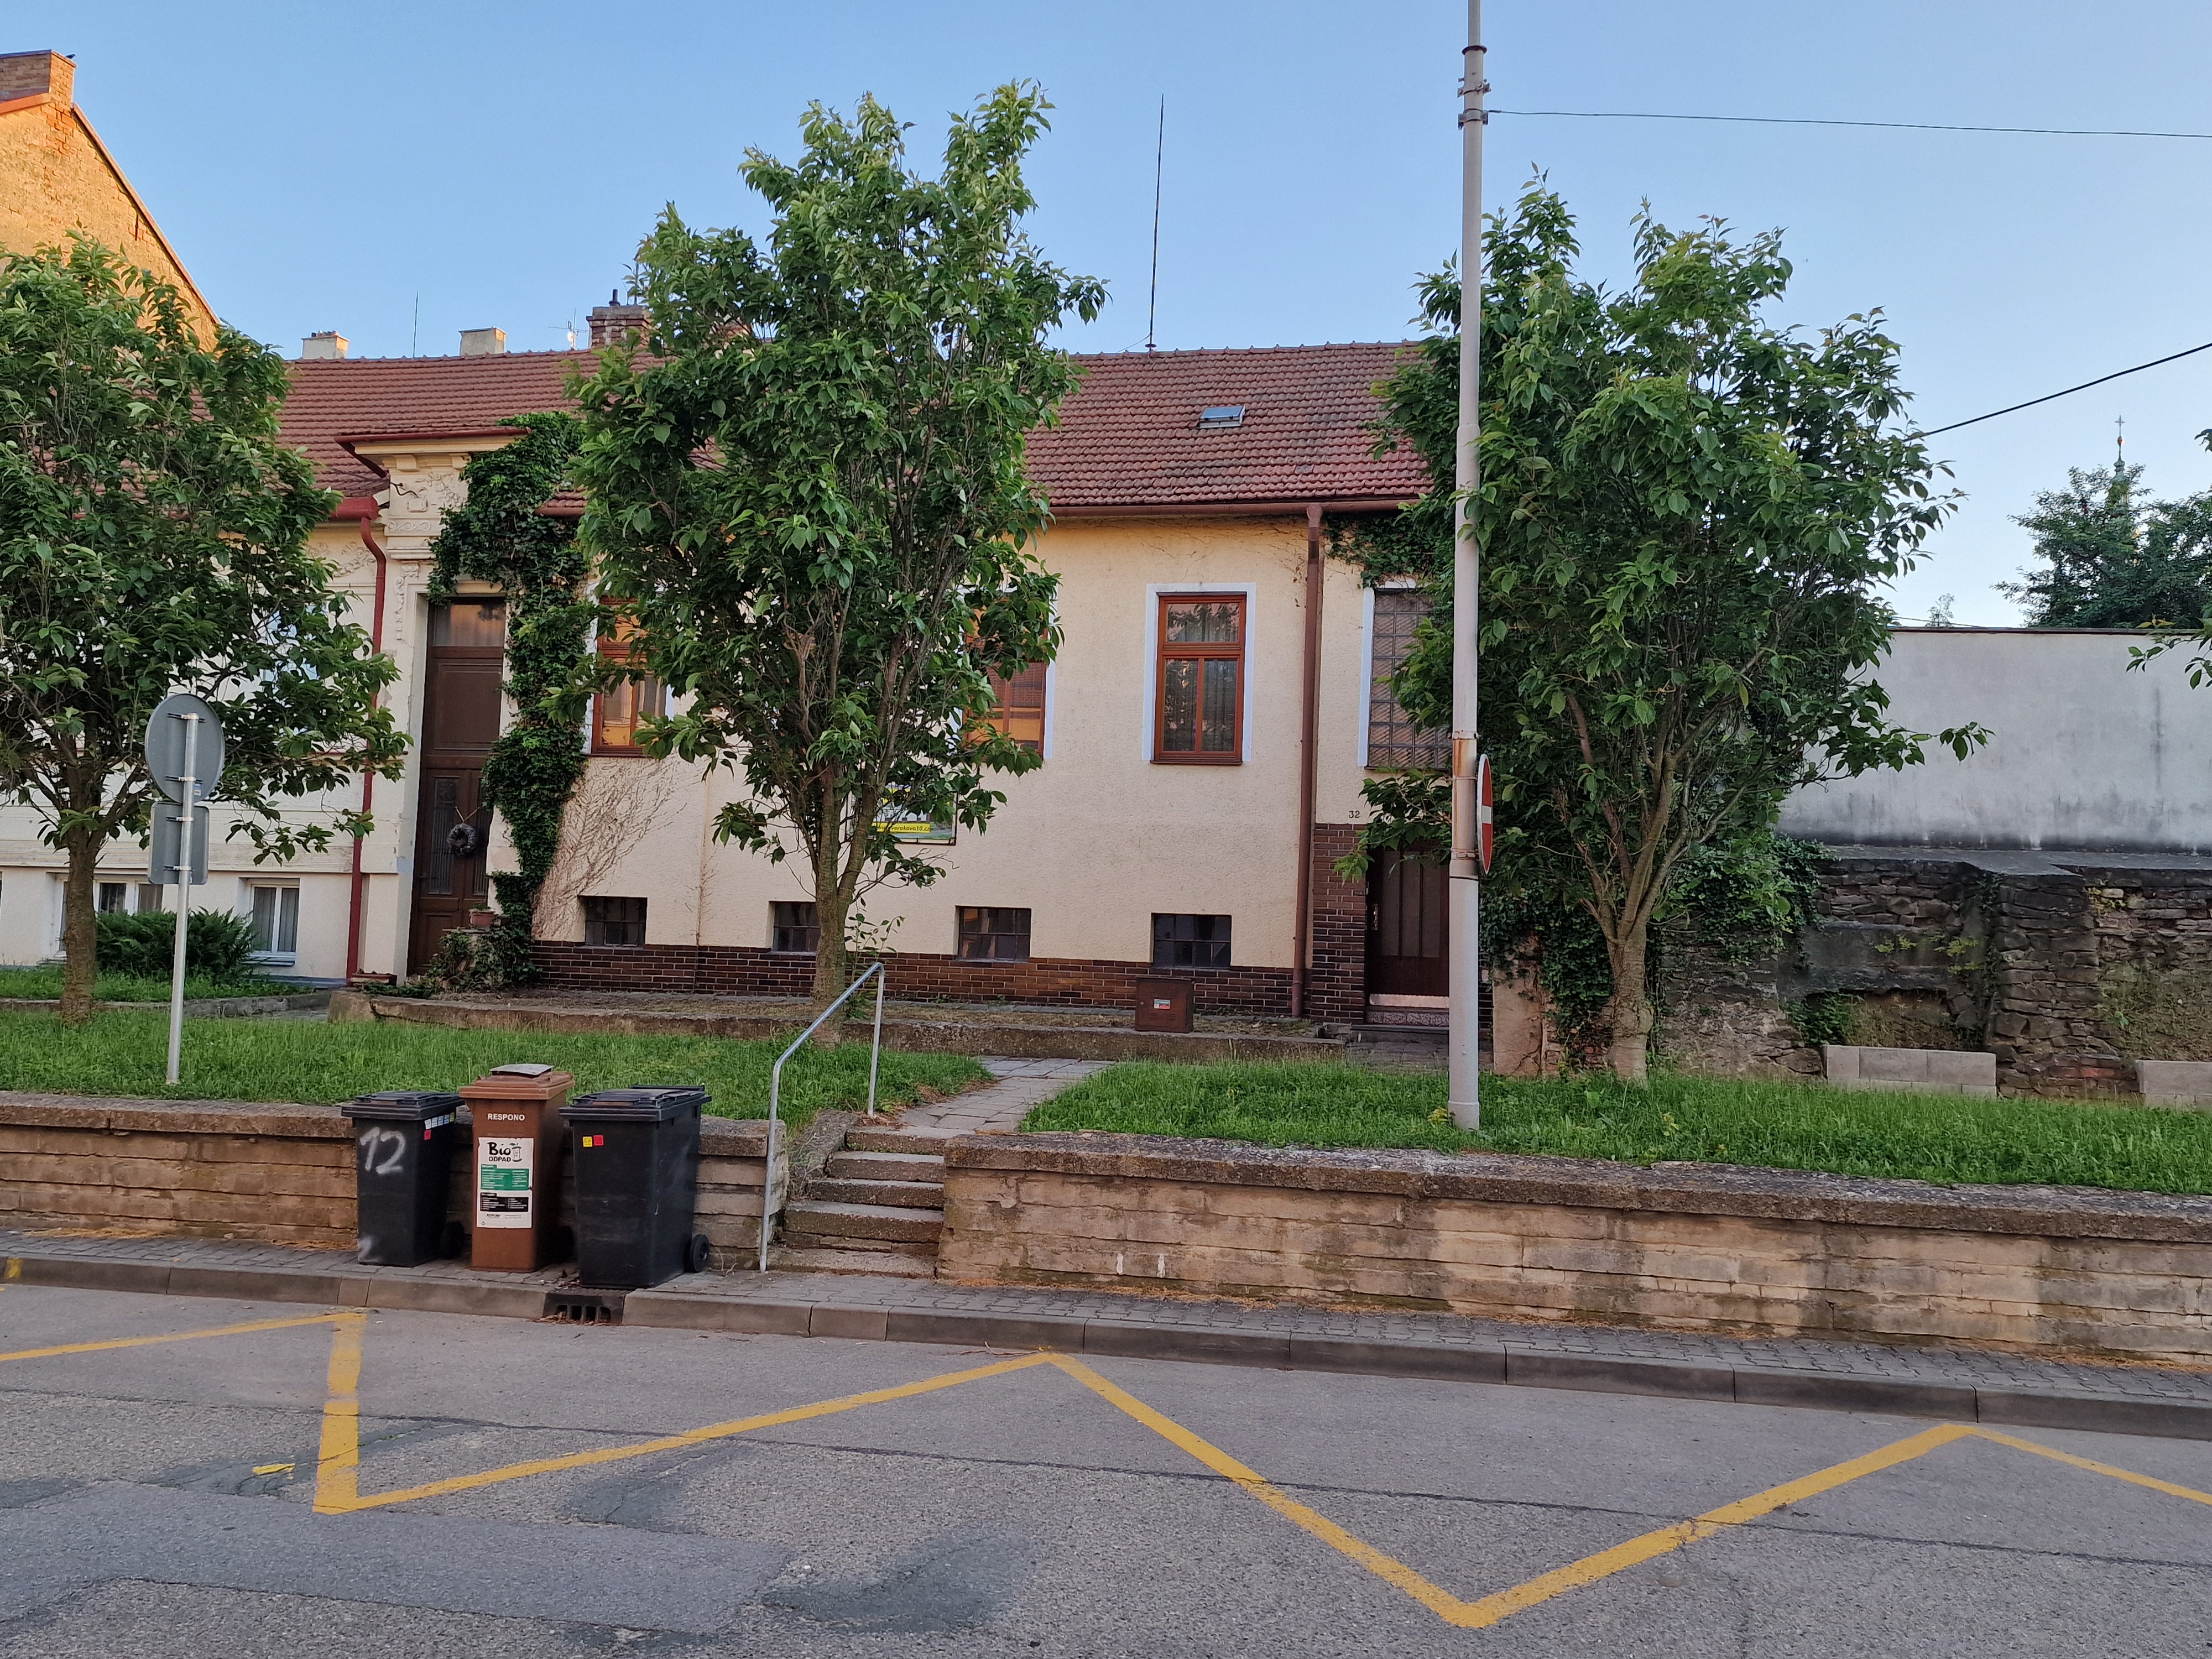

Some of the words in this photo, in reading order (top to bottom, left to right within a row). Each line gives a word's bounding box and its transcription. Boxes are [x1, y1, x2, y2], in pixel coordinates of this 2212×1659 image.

[1349, 810, 1361, 818] 32
[359, 1126, 406, 1175] 12
[487, 1141, 511, 1155] Bio
